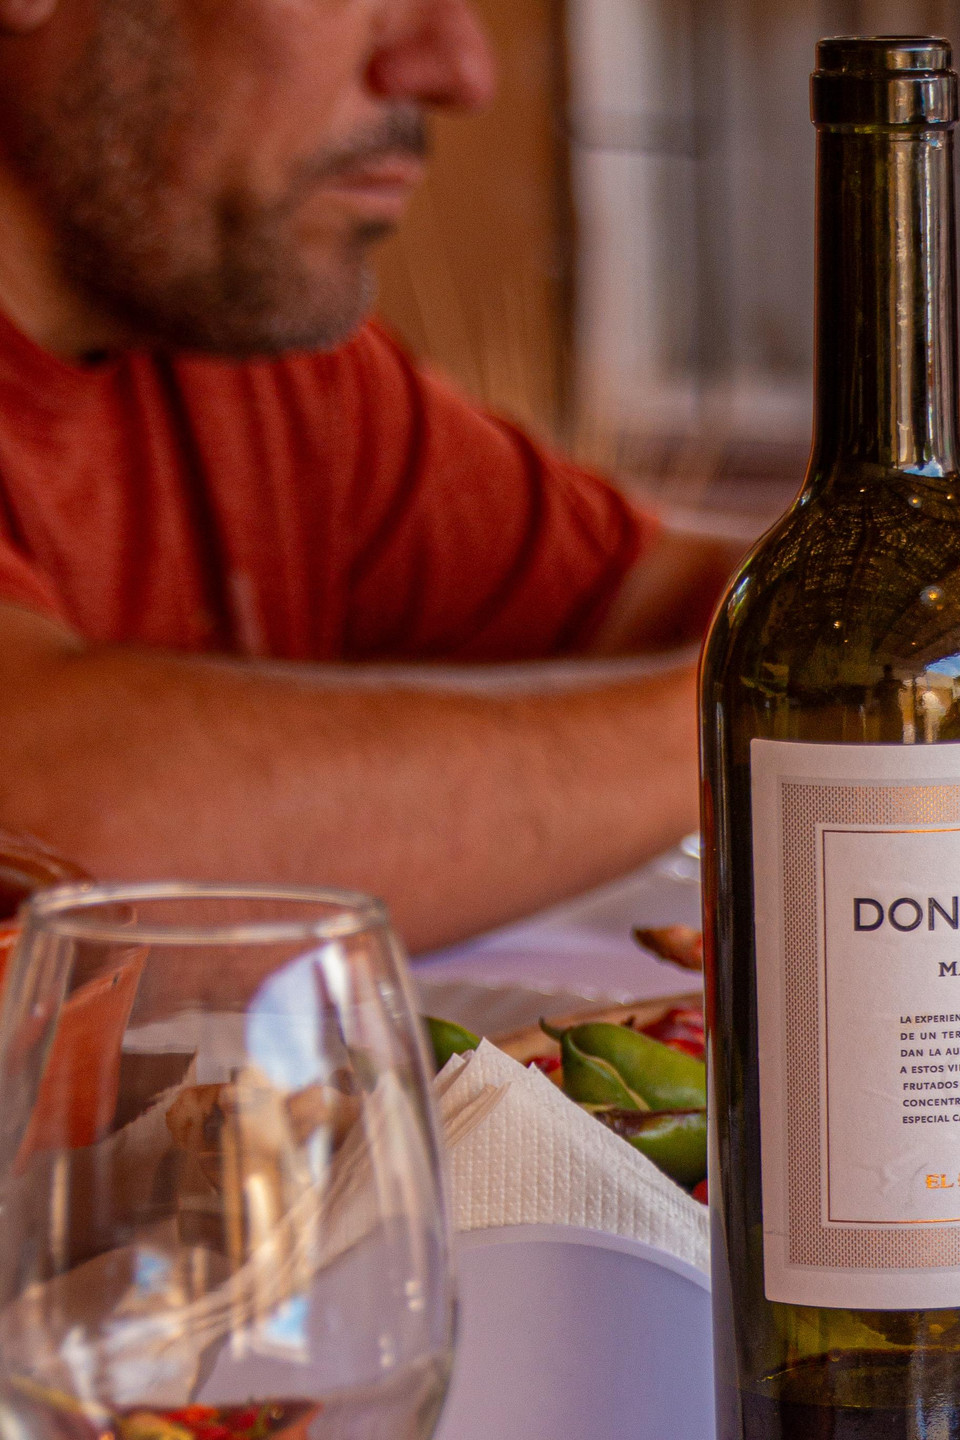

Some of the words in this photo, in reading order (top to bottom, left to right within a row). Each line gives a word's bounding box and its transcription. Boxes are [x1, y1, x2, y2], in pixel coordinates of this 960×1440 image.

[854, 896, 959, 932] DON
[900, 1016, 912, 1024] LA
[900, 1032, 915, 1041] DE
[920, 1031, 936, 1040] UN
[900, 1049, 923, 1057] DAN
[929, 1048, 941, 1056] LA
[900, 1066, 907, 1074] A
[911, 1065, 944, 1074] ESTOS
[903, 1080, 959, 1091] FRUTADOS
[902, 1114, 950, 1124] ESPECIAL
[925, 1173, 954, 1189] EL
